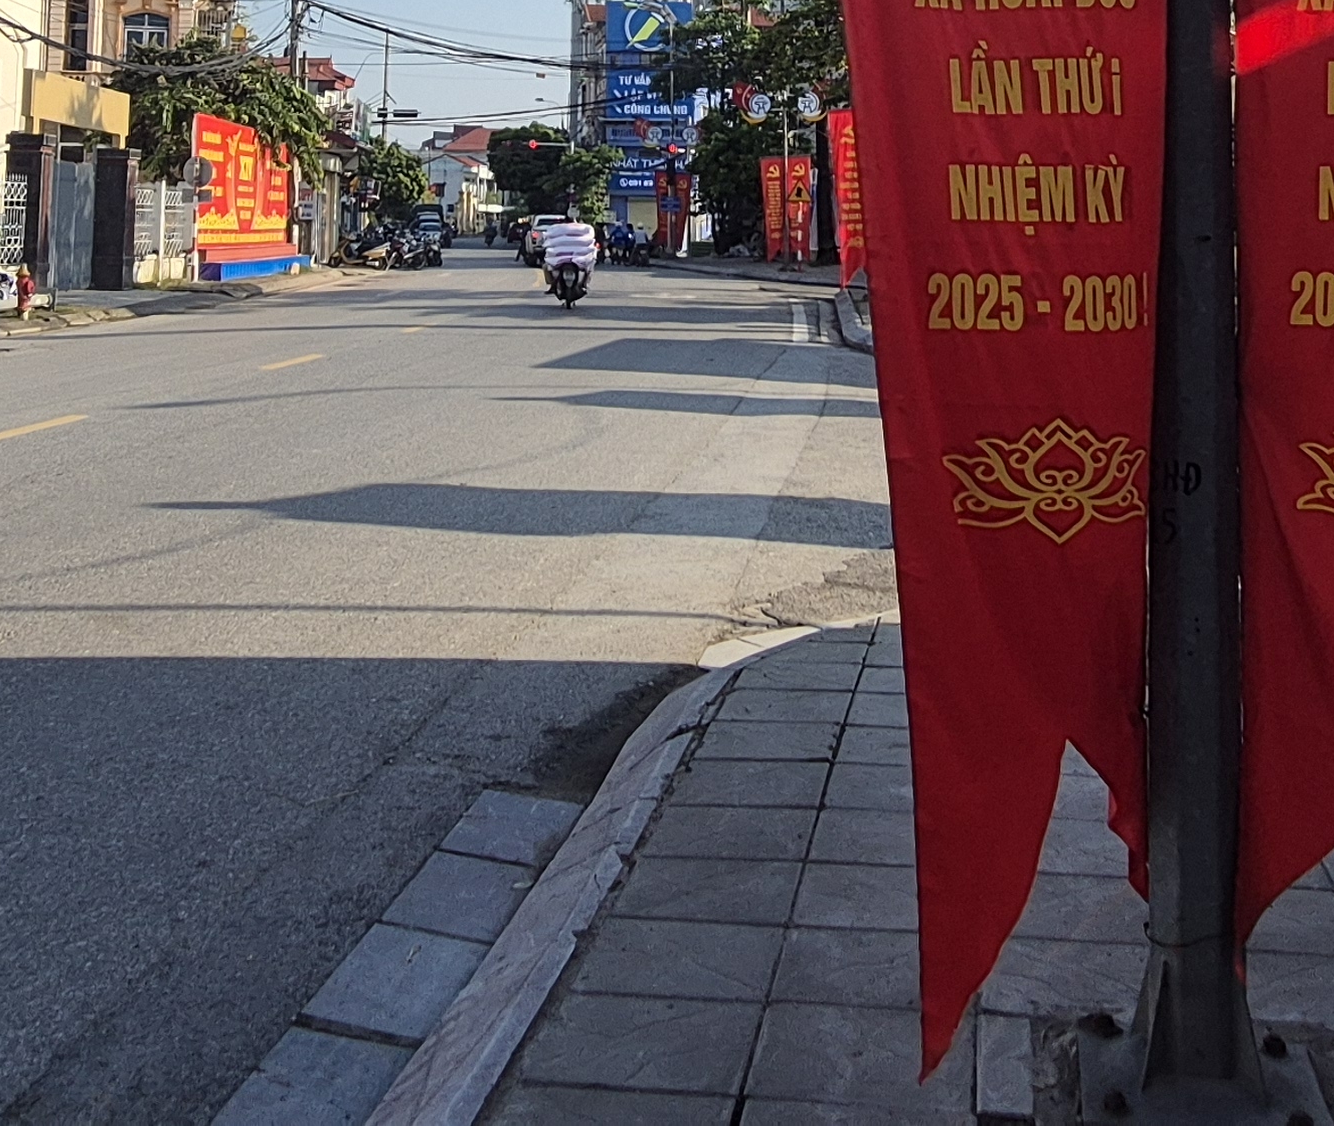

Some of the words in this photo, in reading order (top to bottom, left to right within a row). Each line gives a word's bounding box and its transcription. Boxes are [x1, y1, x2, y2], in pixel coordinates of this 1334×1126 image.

[949, 40, 1023, 115] LẦN
[1032, 41, 1104, 115] THỨ
[948, 154, 1076, 235] NHIỆM
[1085, 155, 1126, 223] KỲ
[928, 273, 1024, 332] 2025
[1037, 300, 1051, 313] -
